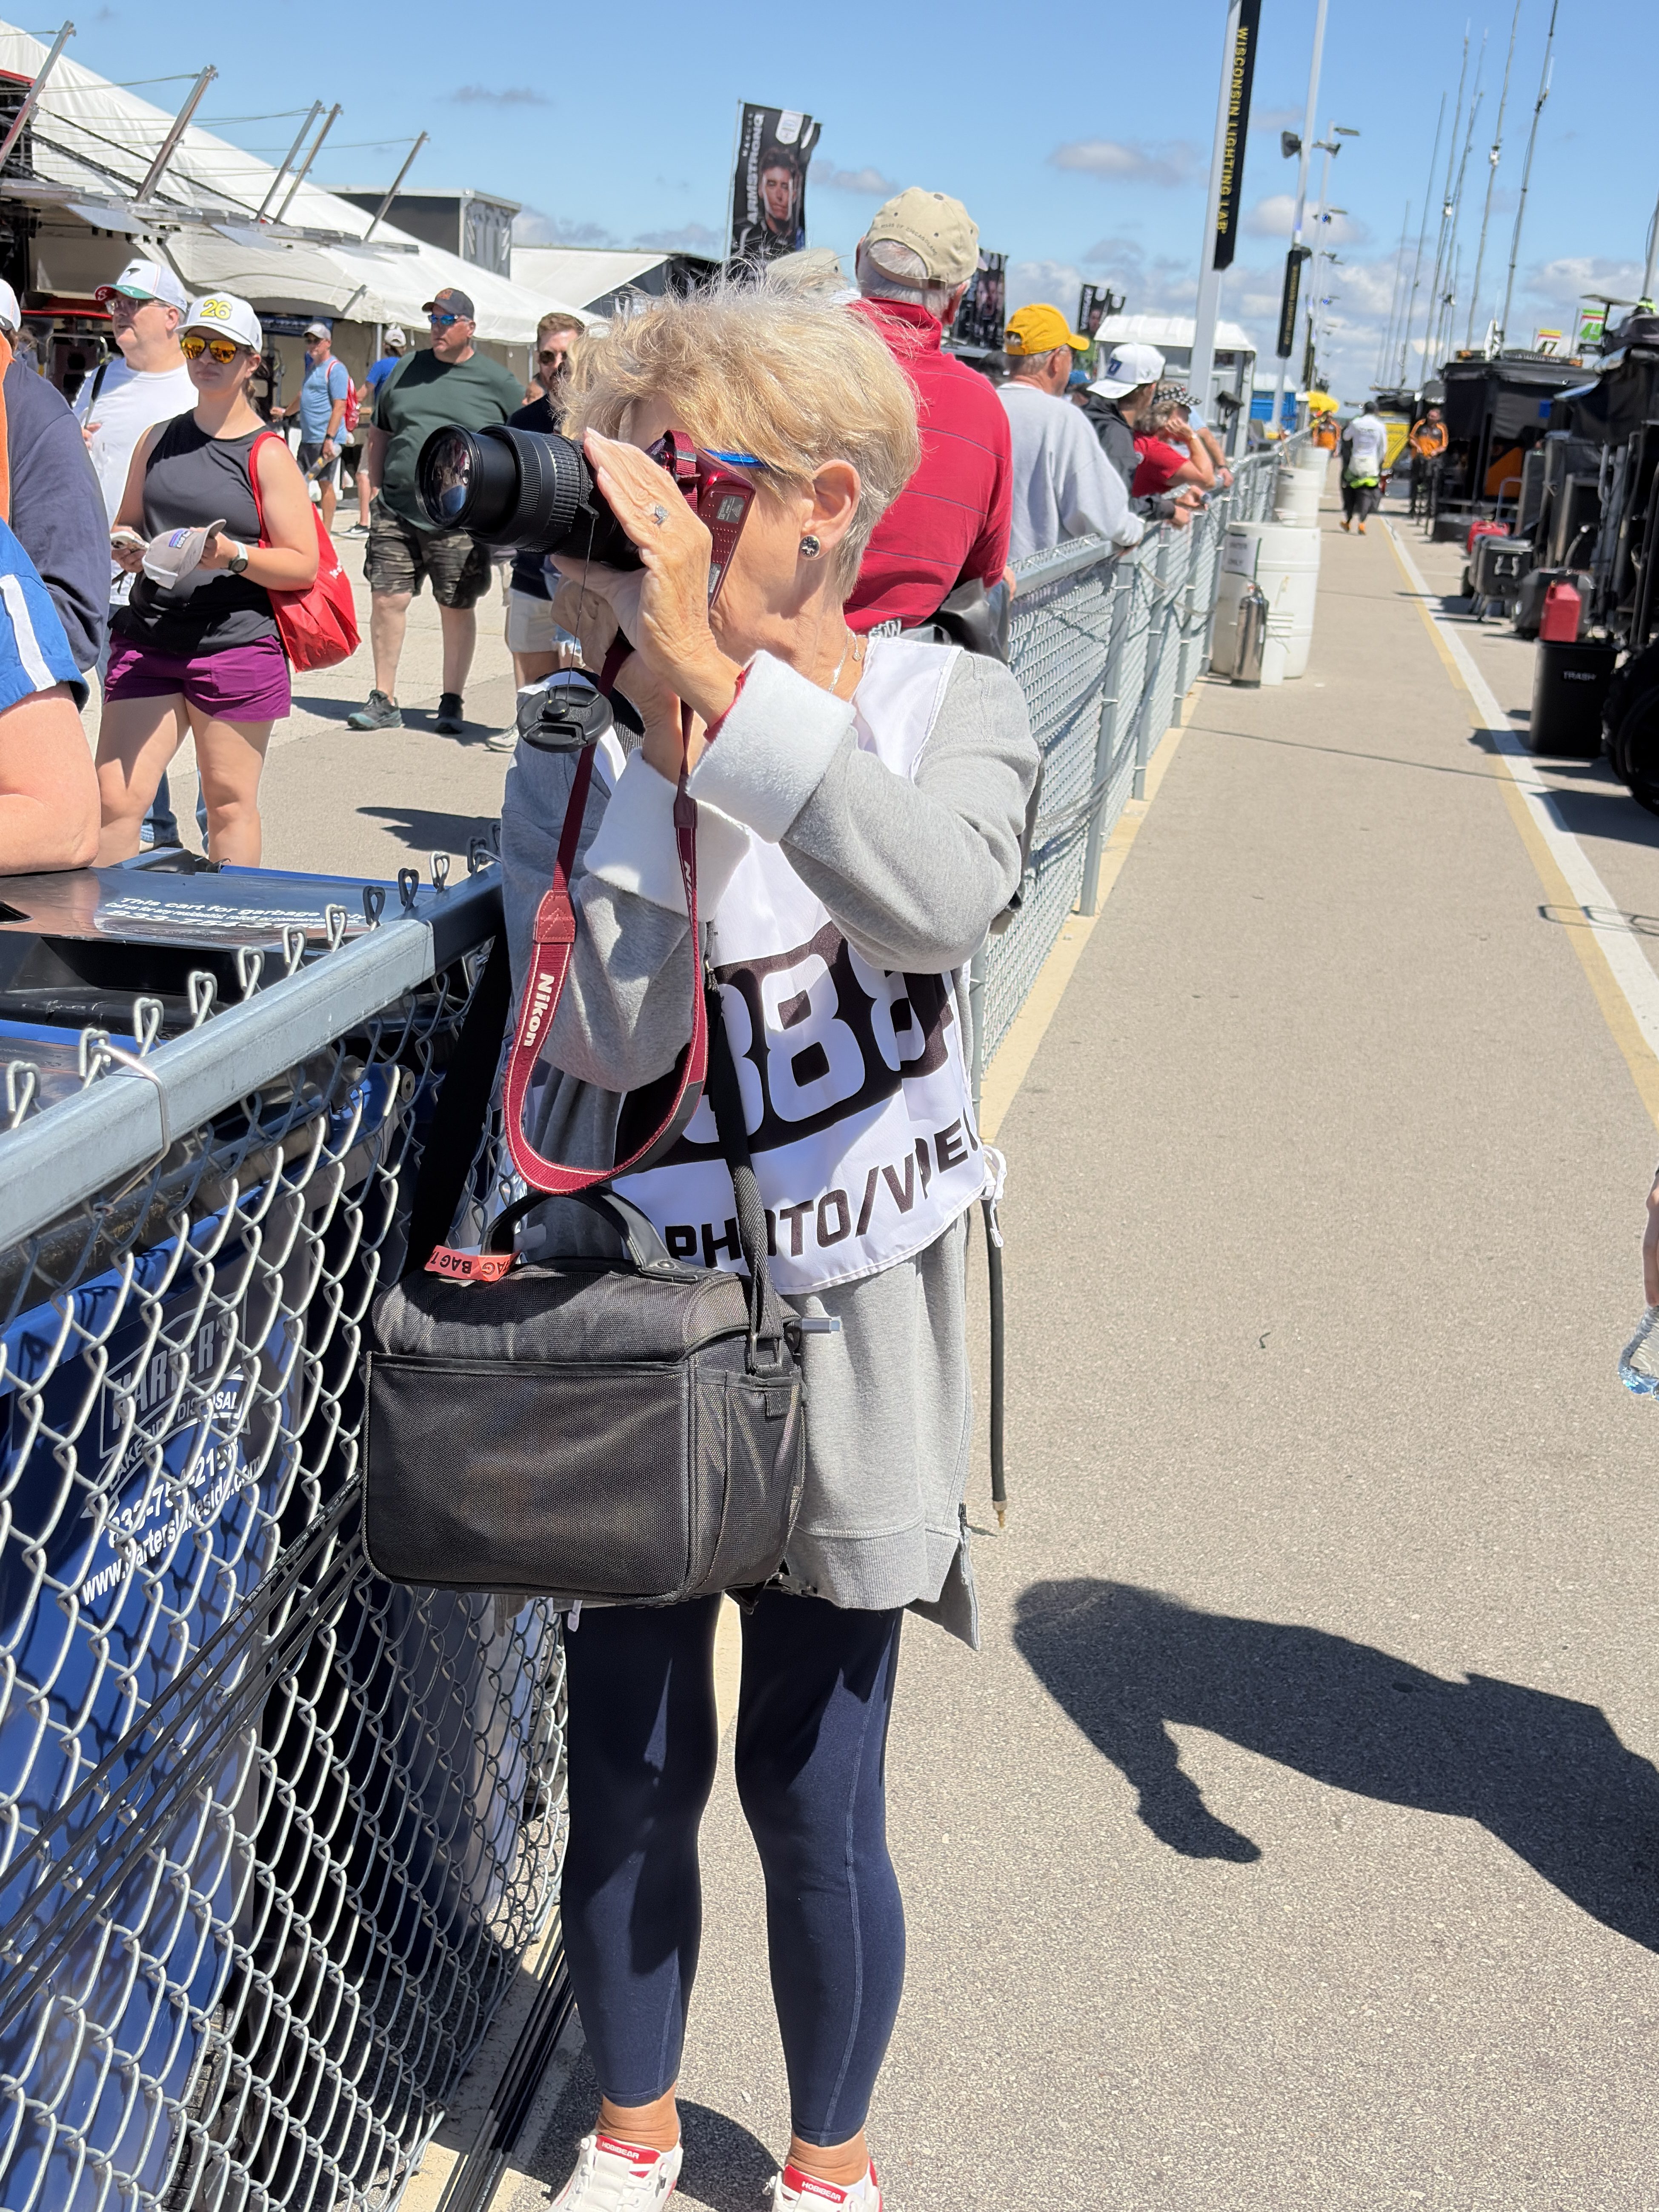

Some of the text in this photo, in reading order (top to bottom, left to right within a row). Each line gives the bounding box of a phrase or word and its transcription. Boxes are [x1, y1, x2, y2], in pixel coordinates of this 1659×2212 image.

[1228, 26, 1249, 116] WISCONSIN
[1220, 120, 1239, 195] LIGHTING
[747, 114, 765, 225] ARMSTRONG
[200, 299, 233, 320] 26
[1563, 670, 1597, 681] TRASH
[121, 897, 161, 906] This
[238, 909, 320, 917] garbage
[173, 911, 227, 920] residential,
[523, 973, 555, 1047] Nikon
[440, 1255, 472, 1274] BAG
[109, 1391, 237, 1491] LAKESID DISSAL
[82, 1455, 261, 1606] www.harterslakesid.com
[601, 2141, 640, 2159] HOBIBEAR
[801, 2181, 842, 2201] HOBIBEAR
